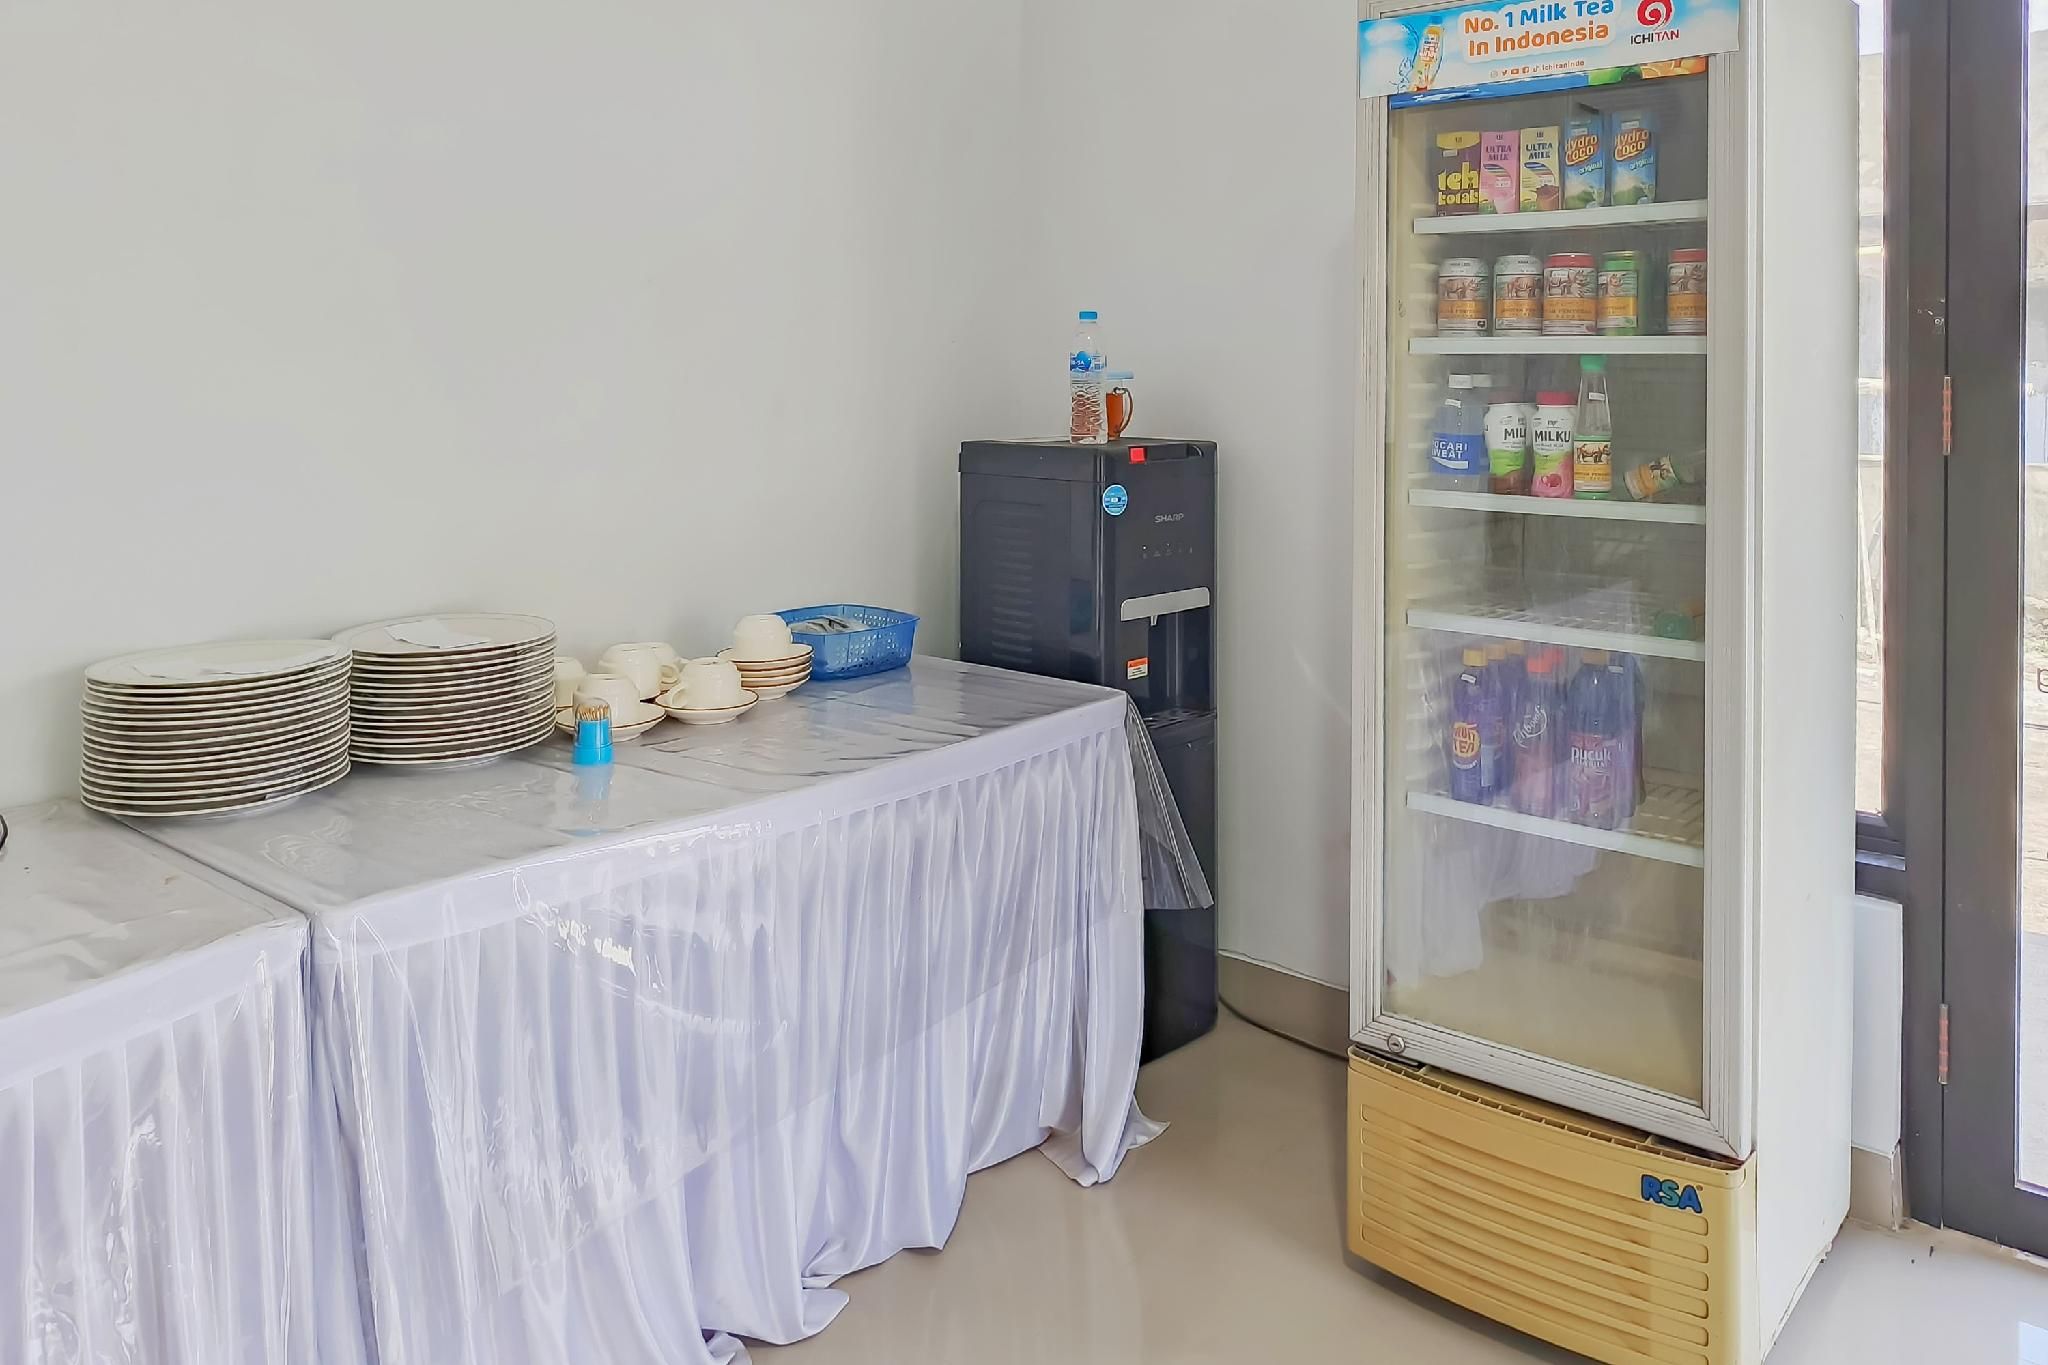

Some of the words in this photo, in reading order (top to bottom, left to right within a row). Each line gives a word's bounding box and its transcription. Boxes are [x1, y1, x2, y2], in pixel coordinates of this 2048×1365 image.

[1465, 18, 1499, 34] No.
[1505, 11, 1513, 28] 1
[1520, 4, 1567, 26] Milk
[1574, 0, 1615, 17] Tea
[1469, 39, 1489, 57] In
[1496, 20, 1610, 53] Indonesia
[1630, 29, 1680, 45] ICHITAN
[1486, 144, 1512, 154] ULTRA
[1526, 142, 1553, 152] ULTRA
[1528, 151, 1551, 161] MILK
[1438, 161, 1479, 191] teh
[1535, 430, 1571, 443] MILKU
[1154, 512, 1185, 523] SHARP
[1641, 1174, 1703, 1214] RSA
